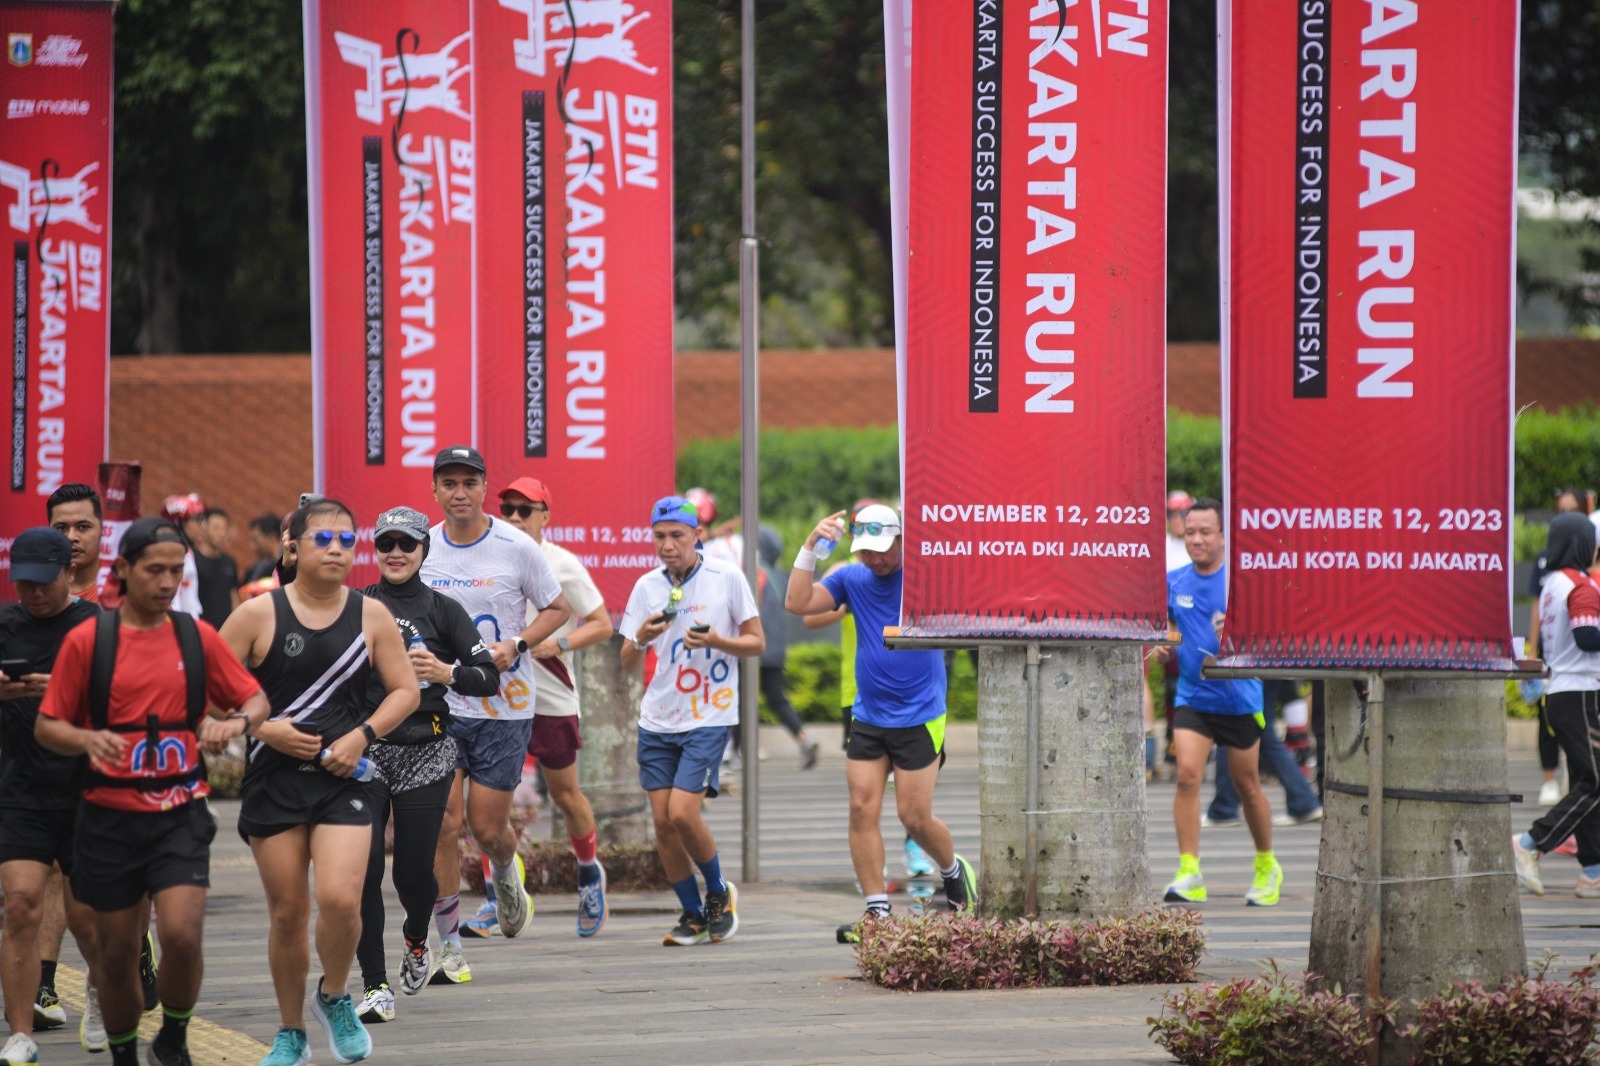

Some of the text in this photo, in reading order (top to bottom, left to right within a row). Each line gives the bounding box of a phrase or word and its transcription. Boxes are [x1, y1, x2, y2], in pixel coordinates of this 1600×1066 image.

[1302, 0, 1325, 134] SUCCESS
[450, 138, 472, 224] BTN
[624, 94, 658, 189] BTN
[976, 80, 996, 192] SUCCESS
[1301, 146, 1323, 205] FOR
[564, 87, 606, 459] JAKARTA RUN
[976, 202, 995, 250] FOR
[79, 242, 103, 312] BTN
[364, 160, 383, 459] JAKARTA SUCCESS FOR INDONESIA
[398, 132, 436, 468] JAKARTA RUN
[525, 118, 543, 449] JAKARTA SUCCESS FOR INDONESIA
[1357, 229, 1416, 398] RUN
[37, 238, 68, 497] JAKARTA RUN
[974, 260, 994, 400] INDONESIA
[1024, 272, 1076, 414] RUN
[591, 527, 617, 544] 12,
[921, 504, 1151, 526] NOVEMBER 12, 2023
[921, 541, 1151, 558] BALAI KOTA DKI JAKARTA
[1240, 507, 1503, 533] NOVEMBER 12, 2023
[1240, 551, 1503, 572] BALAI KOTA DKI JAKARTA
[431, 578, 495, 588] BTN mobile
